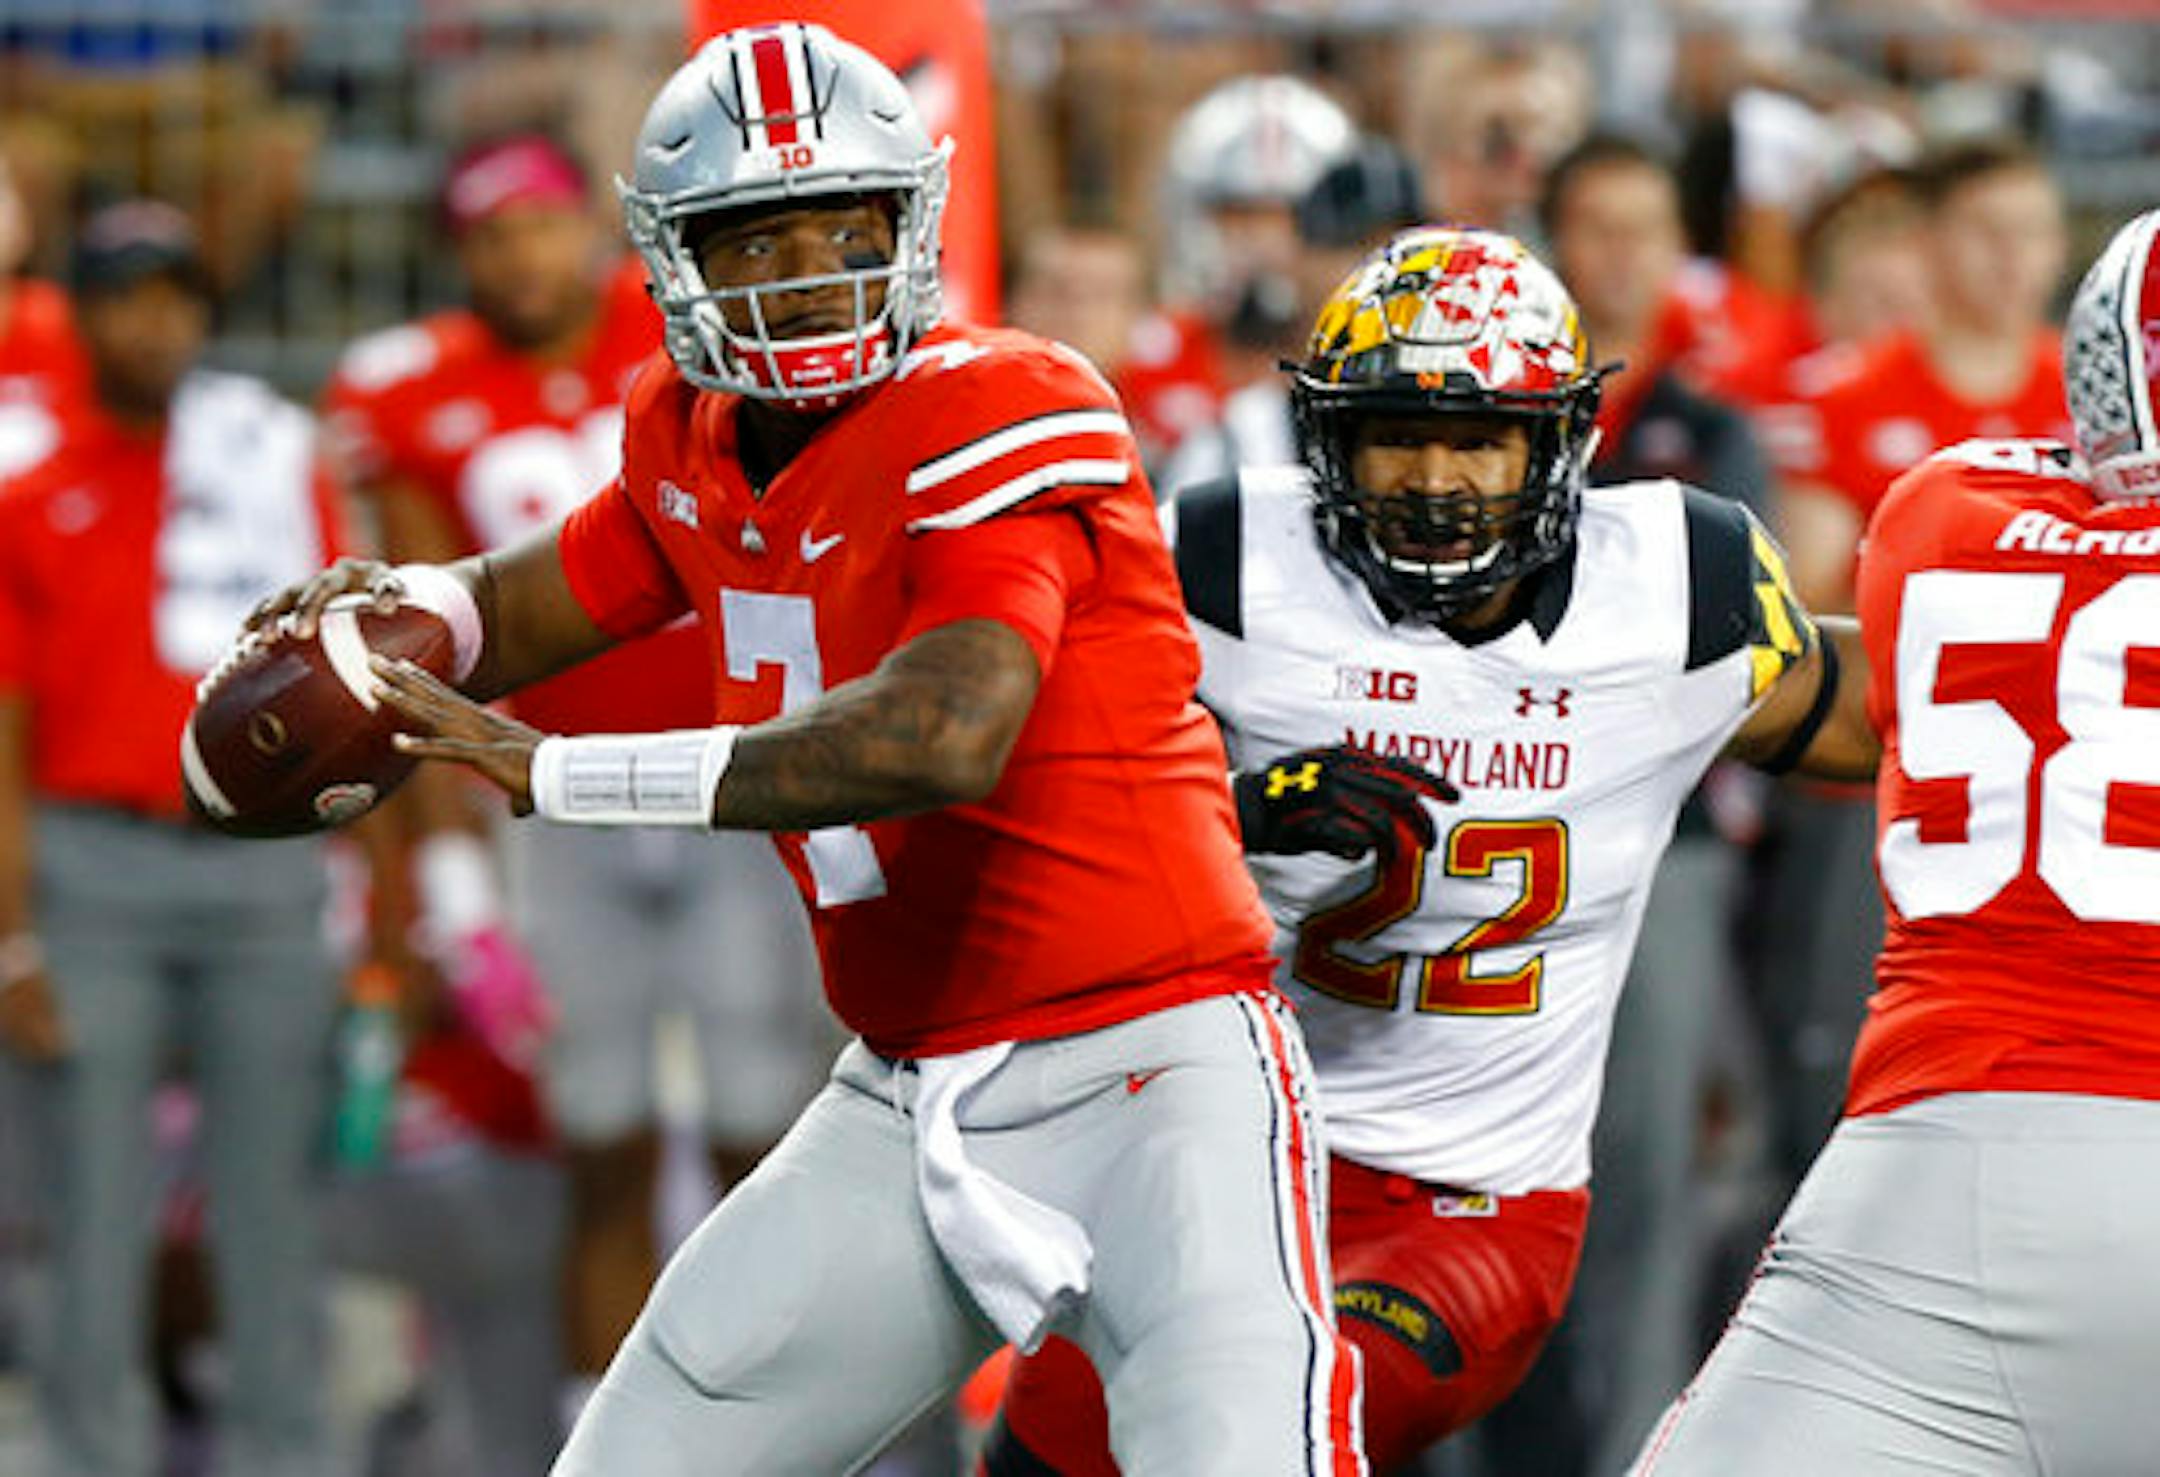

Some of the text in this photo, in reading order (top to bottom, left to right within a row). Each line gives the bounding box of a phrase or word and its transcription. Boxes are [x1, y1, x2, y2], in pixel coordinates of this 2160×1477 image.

[779, 146, 813, 170] 10
[1879, 569, 2160, 924] 58
[1292, 818, 1570, 1017] 22
[1333, 1289, 1429, 1342] ARYLAND
